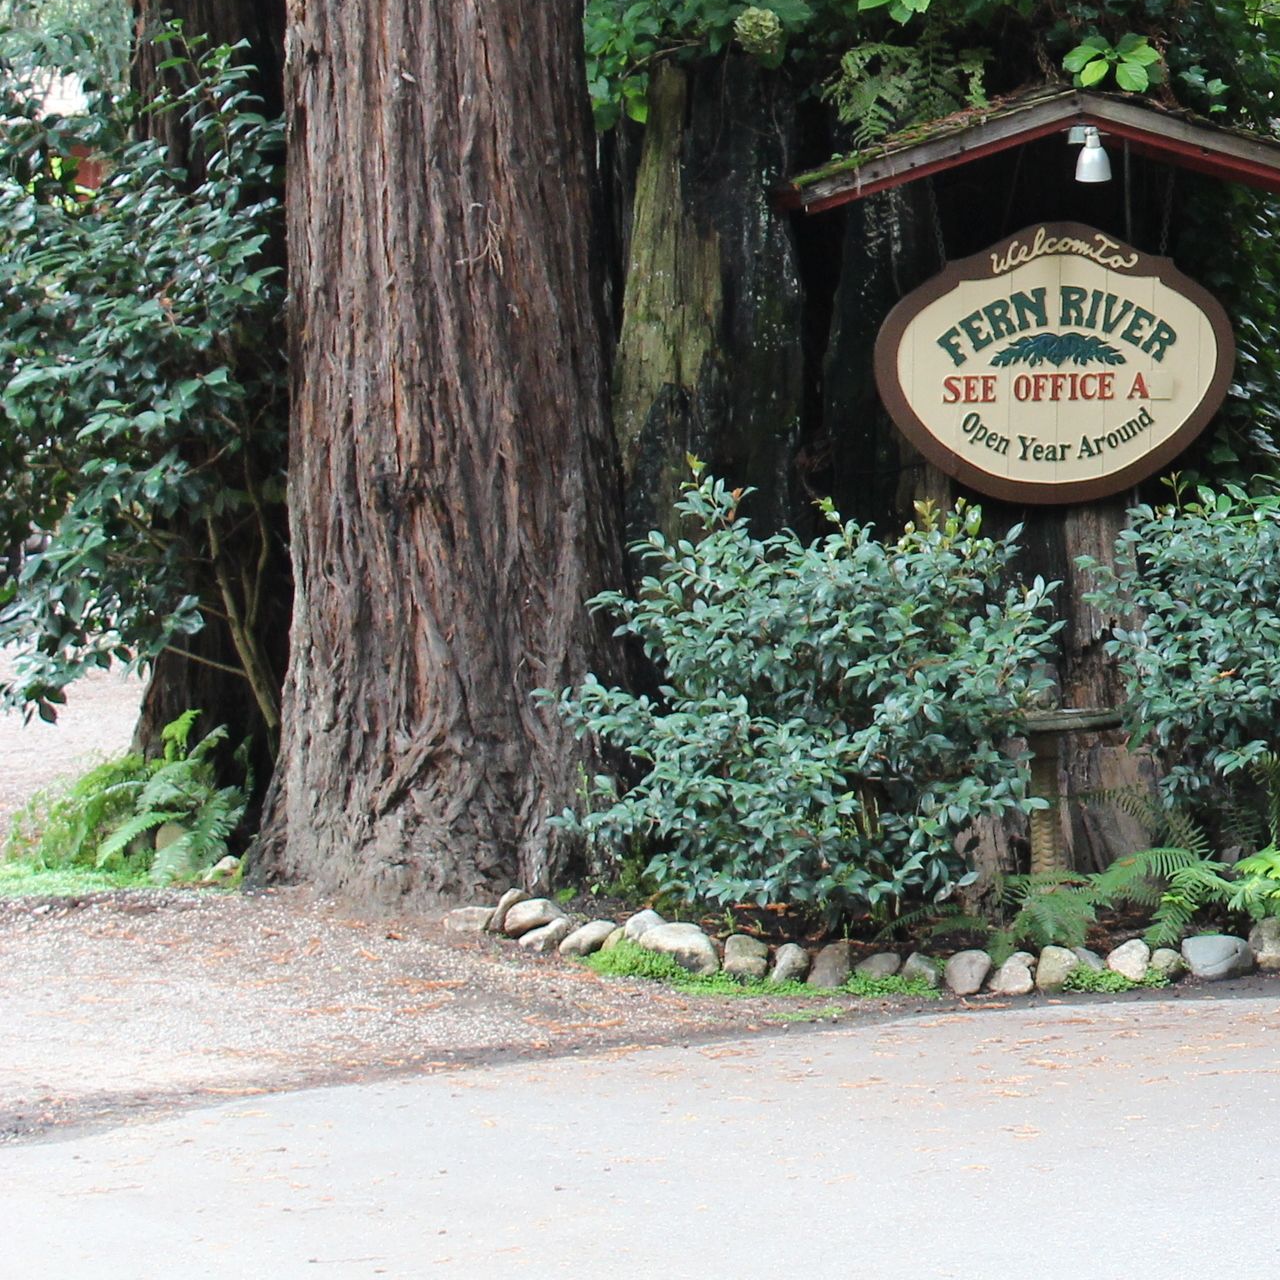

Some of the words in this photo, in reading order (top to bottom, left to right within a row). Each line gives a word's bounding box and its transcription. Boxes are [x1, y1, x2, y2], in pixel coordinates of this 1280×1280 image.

[936, 286, 1049, 367] FERN
[1059, 285, 1177, 363] RIVER
[943, 375, 997, 403] SEE
[1013, 372, 1115, 402] OFFICE
[1127, 371, 1150, 399] A
[962, 411, 1011, 455] Open
[1017, 435, 1072, 462] Year
[1077, 406, 1155, 459] Around
